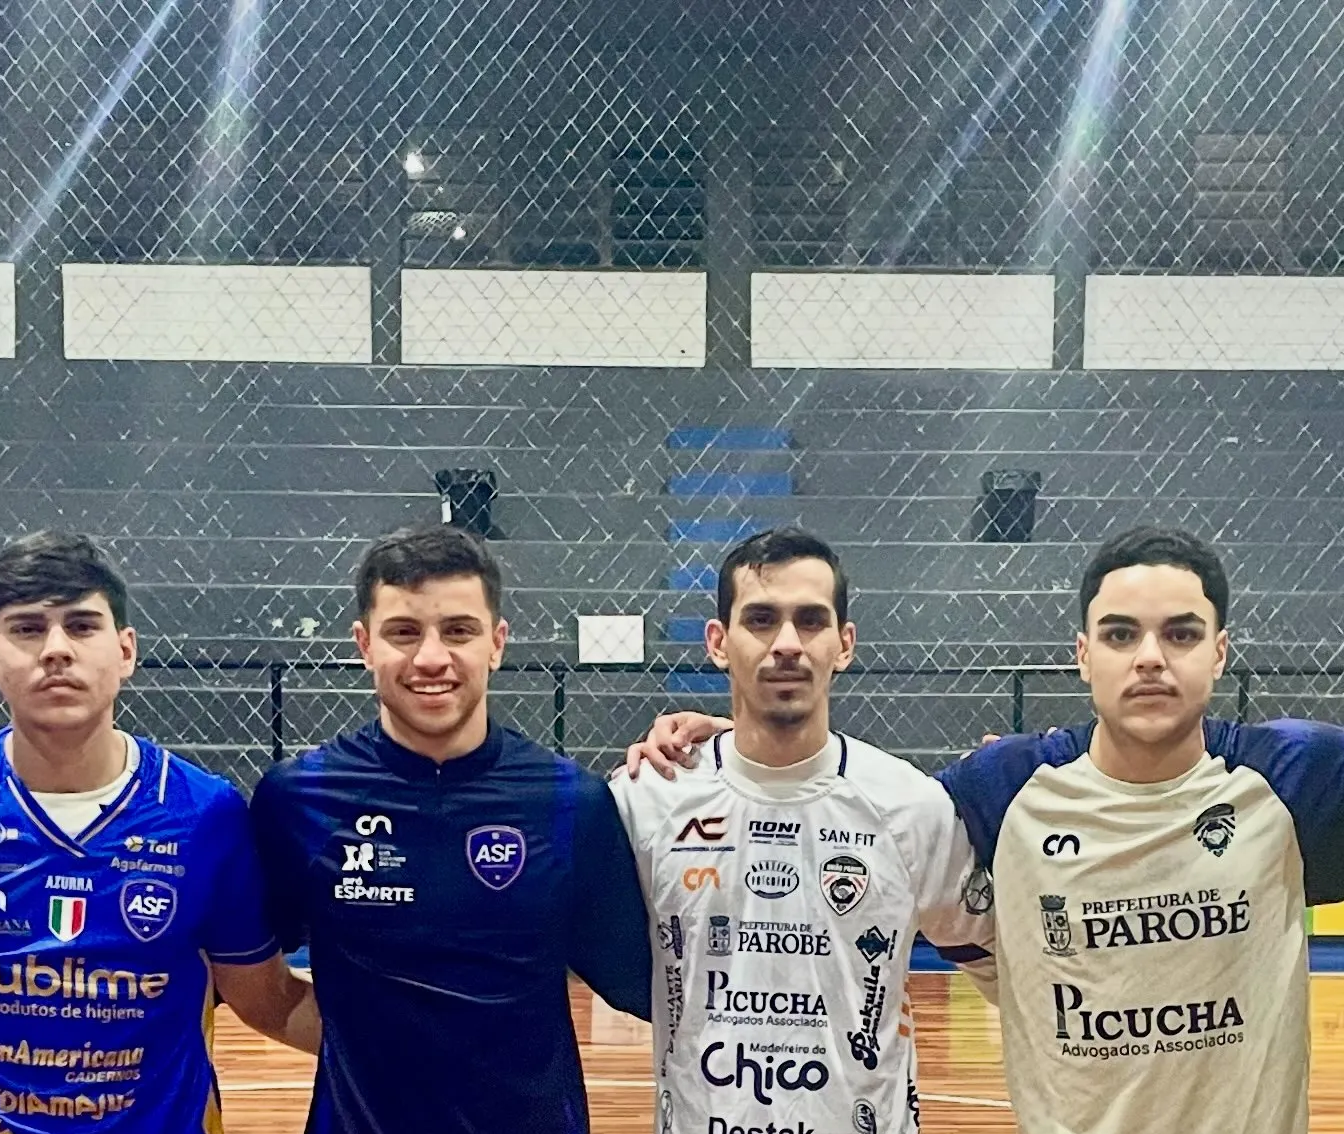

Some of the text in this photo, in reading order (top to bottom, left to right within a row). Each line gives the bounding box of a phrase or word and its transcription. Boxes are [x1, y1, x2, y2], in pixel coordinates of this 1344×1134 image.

[146, 839, 178, 856] Toll
[819, 828, 877, 847] SAN FIT
[110, 856, 173, 874] Agafarma
[474, 843, 519, 864] ASF
[127, 894, 171, 916] ASF
[1082, 888, 1221, 915] PREFEITURA DE
[1081, 889, 1251, 949] PAROBÉ
[737, 929, 832, 957] PAROBÉ
[705, 970, 829, 1016] PICUCHA
[60, 1005, 82, 1019] de
[86, 1003, 145, 1024] higiene
[707, 1013, 765, 1026] Advogados
[1051, 983, 1244, 1041] PICUCHA
[1061, 1031, 1244, 1060] Advogados Associados
[700, 1041, 831, 1105] Chico
